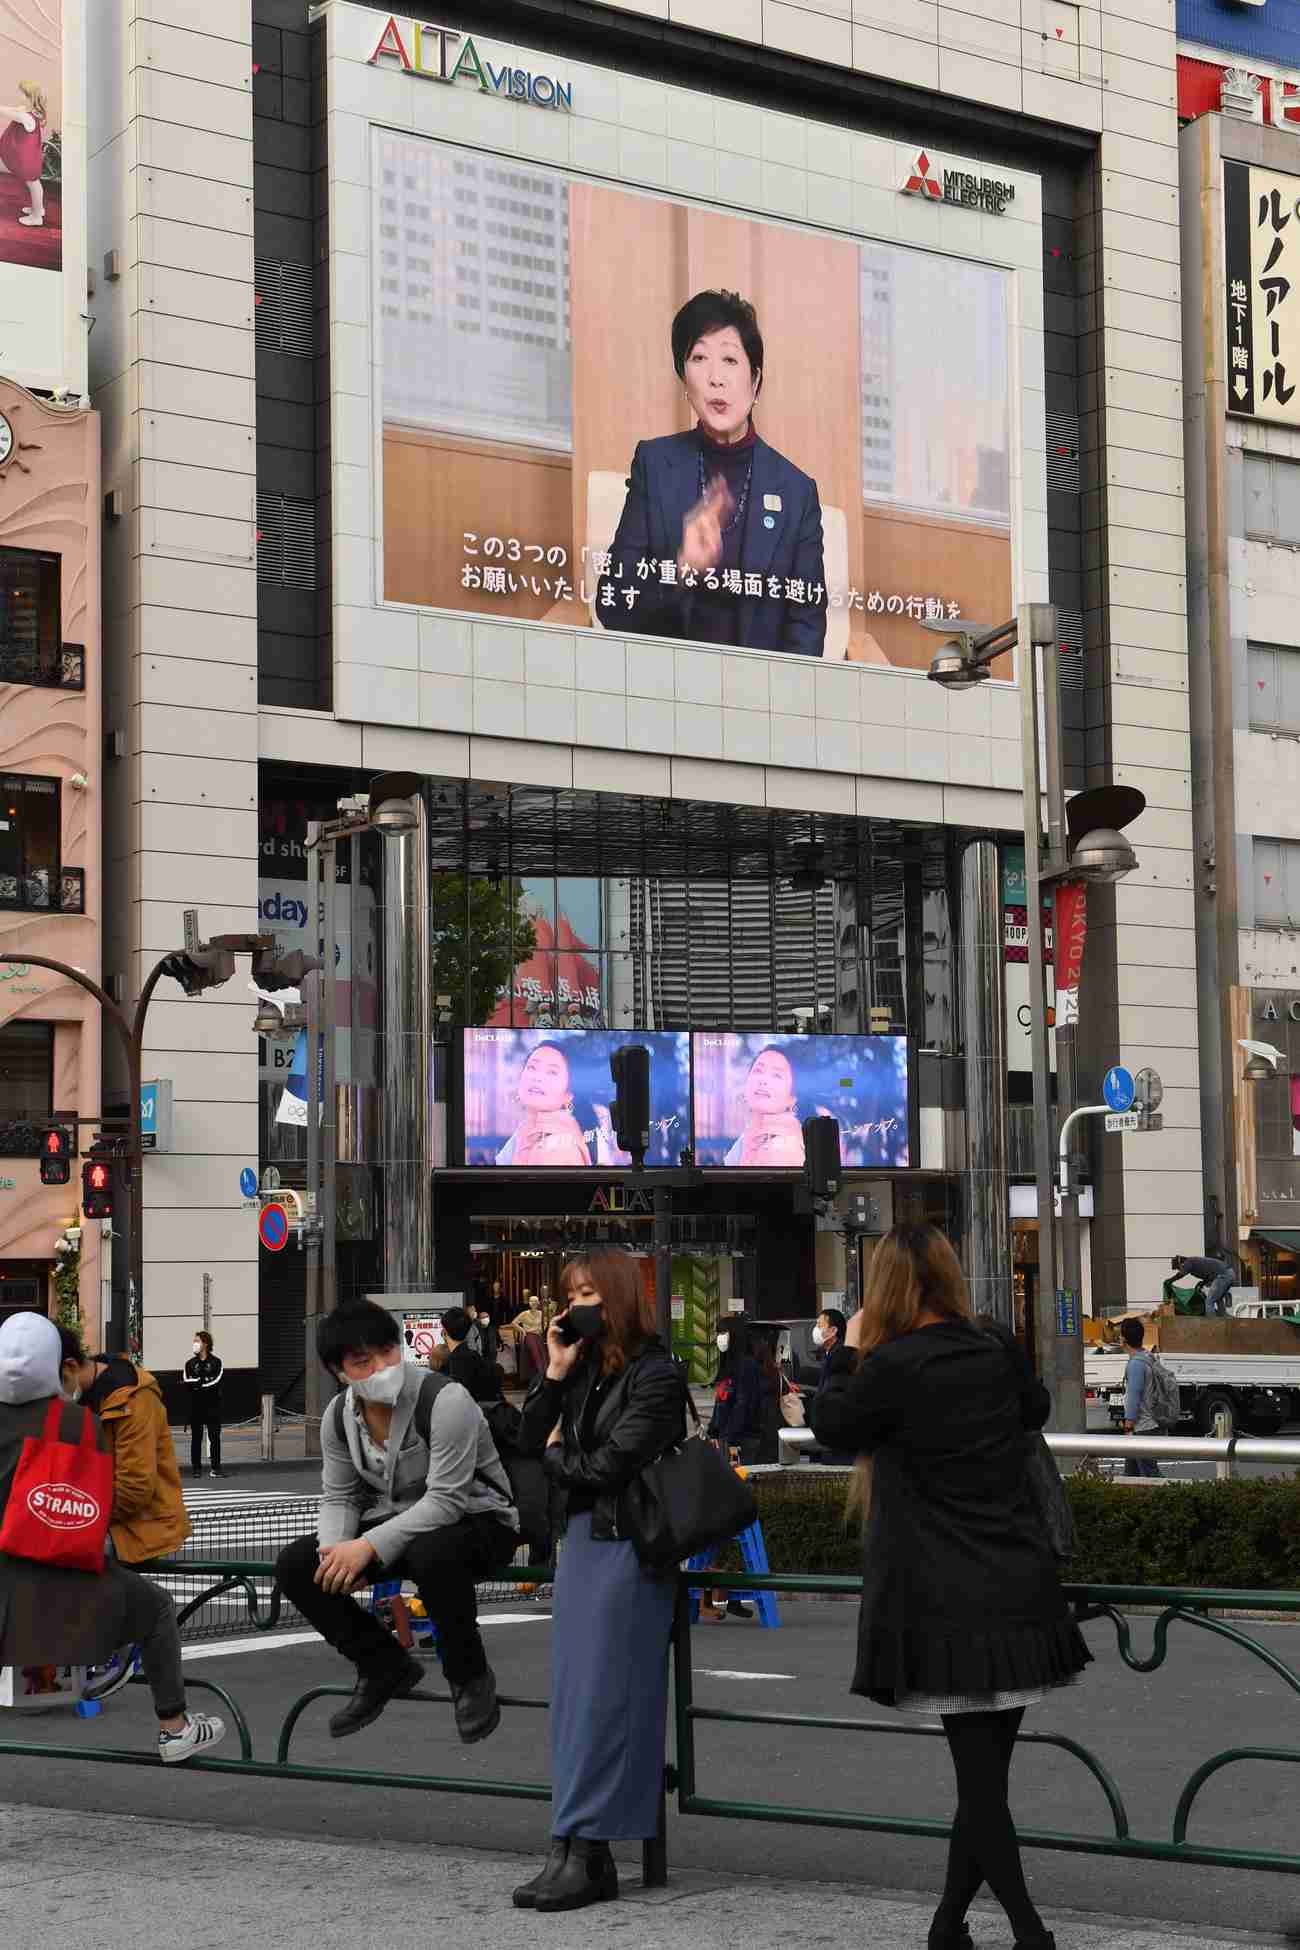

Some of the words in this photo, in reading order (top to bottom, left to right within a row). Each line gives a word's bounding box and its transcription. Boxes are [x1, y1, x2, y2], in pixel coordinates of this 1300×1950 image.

[367, 15, 489, 92] ALTA
[485, 61, 573, 109] VISION
[943, 168, 1016, 201] MITSUBISHI
[943, 184, 1007, 215] ELECTRIC
[1230, 279, 1249, 370] 地下1階
[1258, 188, 1297, 406] ルノアール
[460, 562, 642, 611] お願いいたします
[1067, 879, 1087, 960] OKYO
[32, 1491, 96, 1519] STRAND
